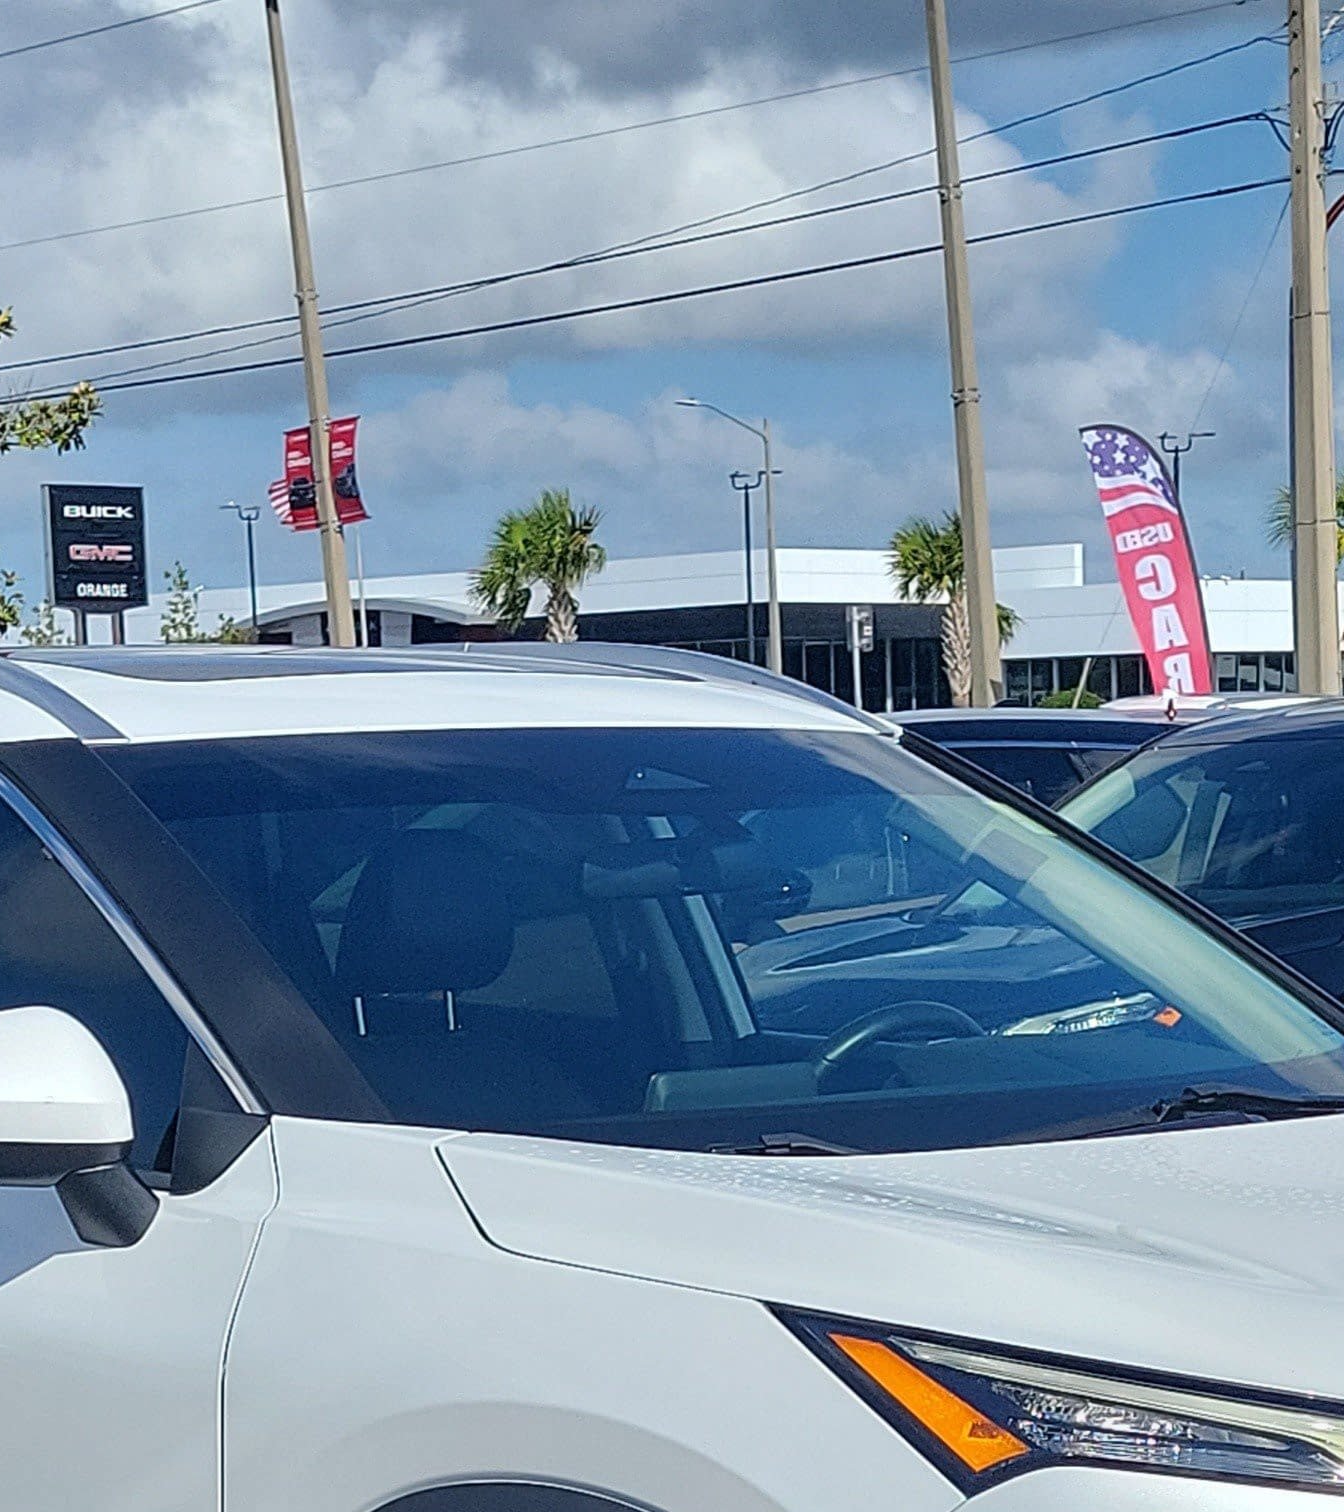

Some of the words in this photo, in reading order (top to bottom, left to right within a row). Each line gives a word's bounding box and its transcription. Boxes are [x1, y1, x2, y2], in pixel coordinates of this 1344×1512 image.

[63, 504, 136, 520] BUICK
[68, 543, 134, 562] GMC
[76, 582, 128, 598] ORANGE
